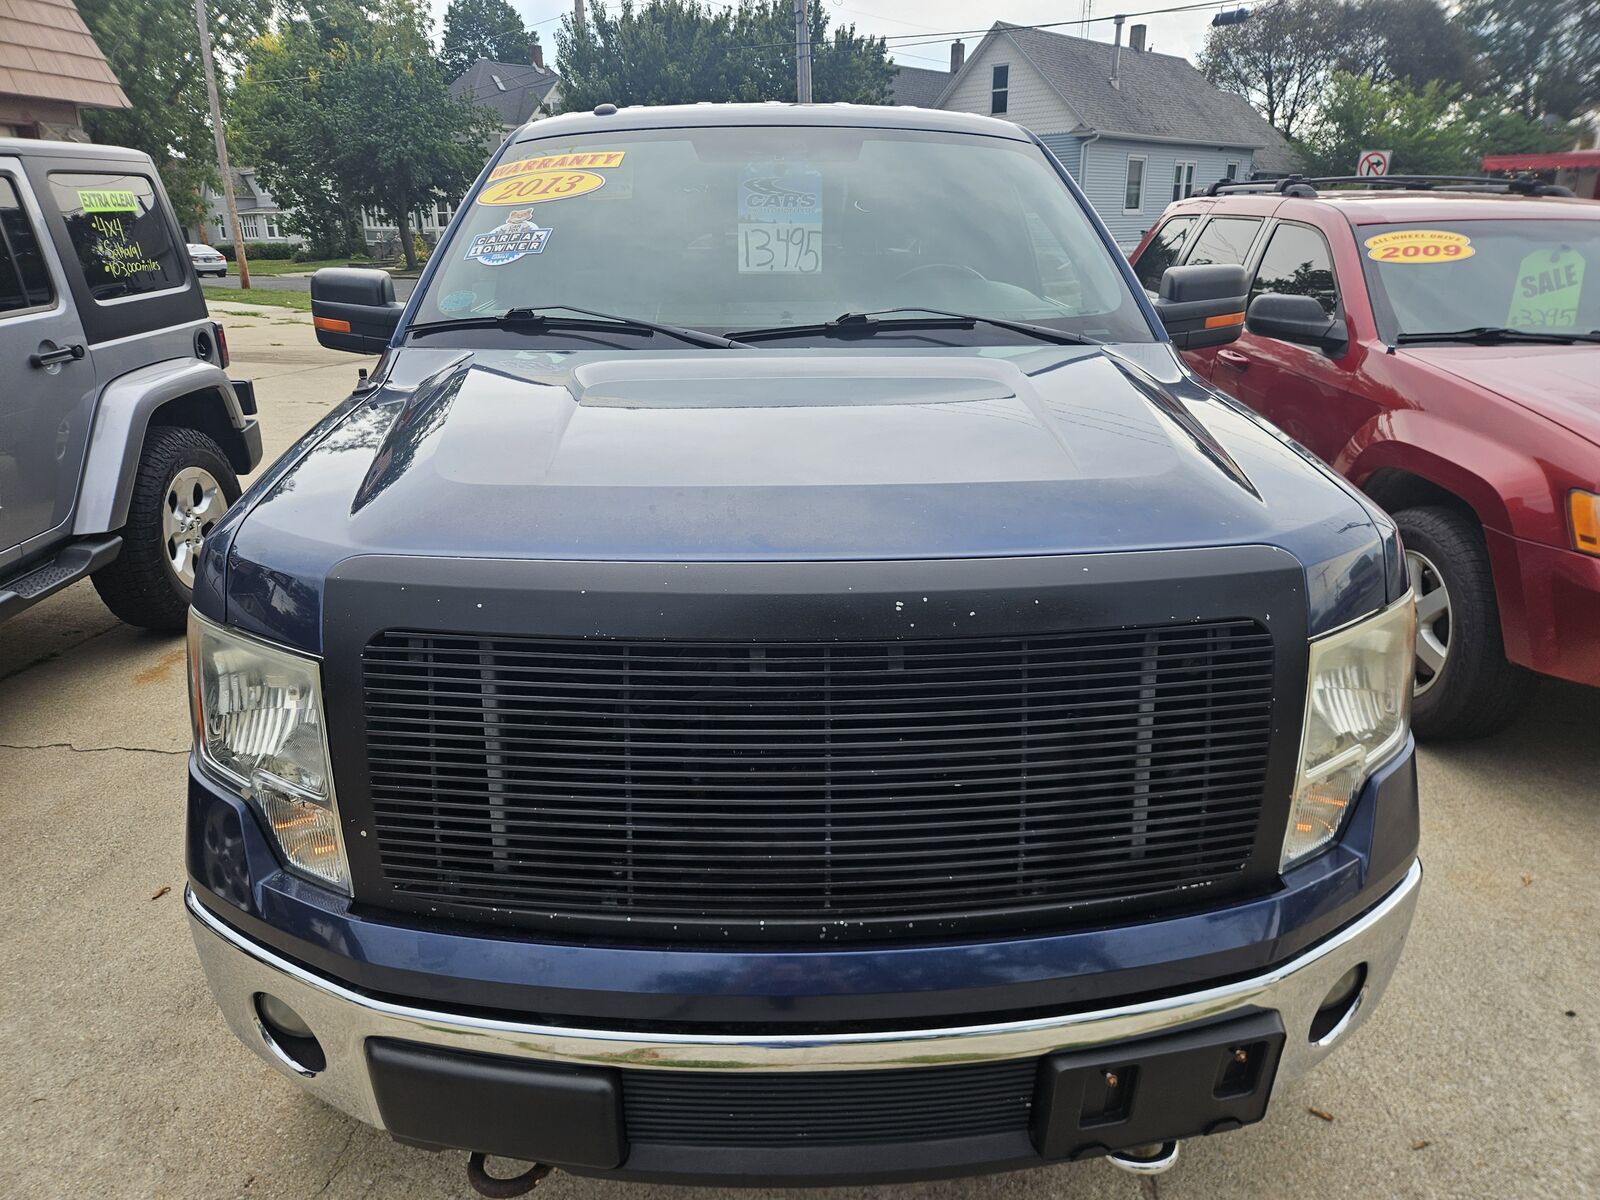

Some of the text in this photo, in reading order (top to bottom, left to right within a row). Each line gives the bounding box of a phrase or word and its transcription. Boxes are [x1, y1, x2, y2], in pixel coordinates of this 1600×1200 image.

[493, 153, 620, 177] WARRANTY
[492, 174, 585, 202] 2013
[80, 192, 136, 208] EXTRA CLEAN
[746, 193, 816, 207] CARS
[476, 232, 544, 245] CARFAX
[1373, 237, 1388, 246] ALL
[1430, 233, 1463, 241] DRIVE
[472, 242, 539, 255] 1 OWNER
[744, 227, 822, 272] 13,495
[1380, 244, 1462, 259] 2009
[1520, 264, 1578, 298] SALE
